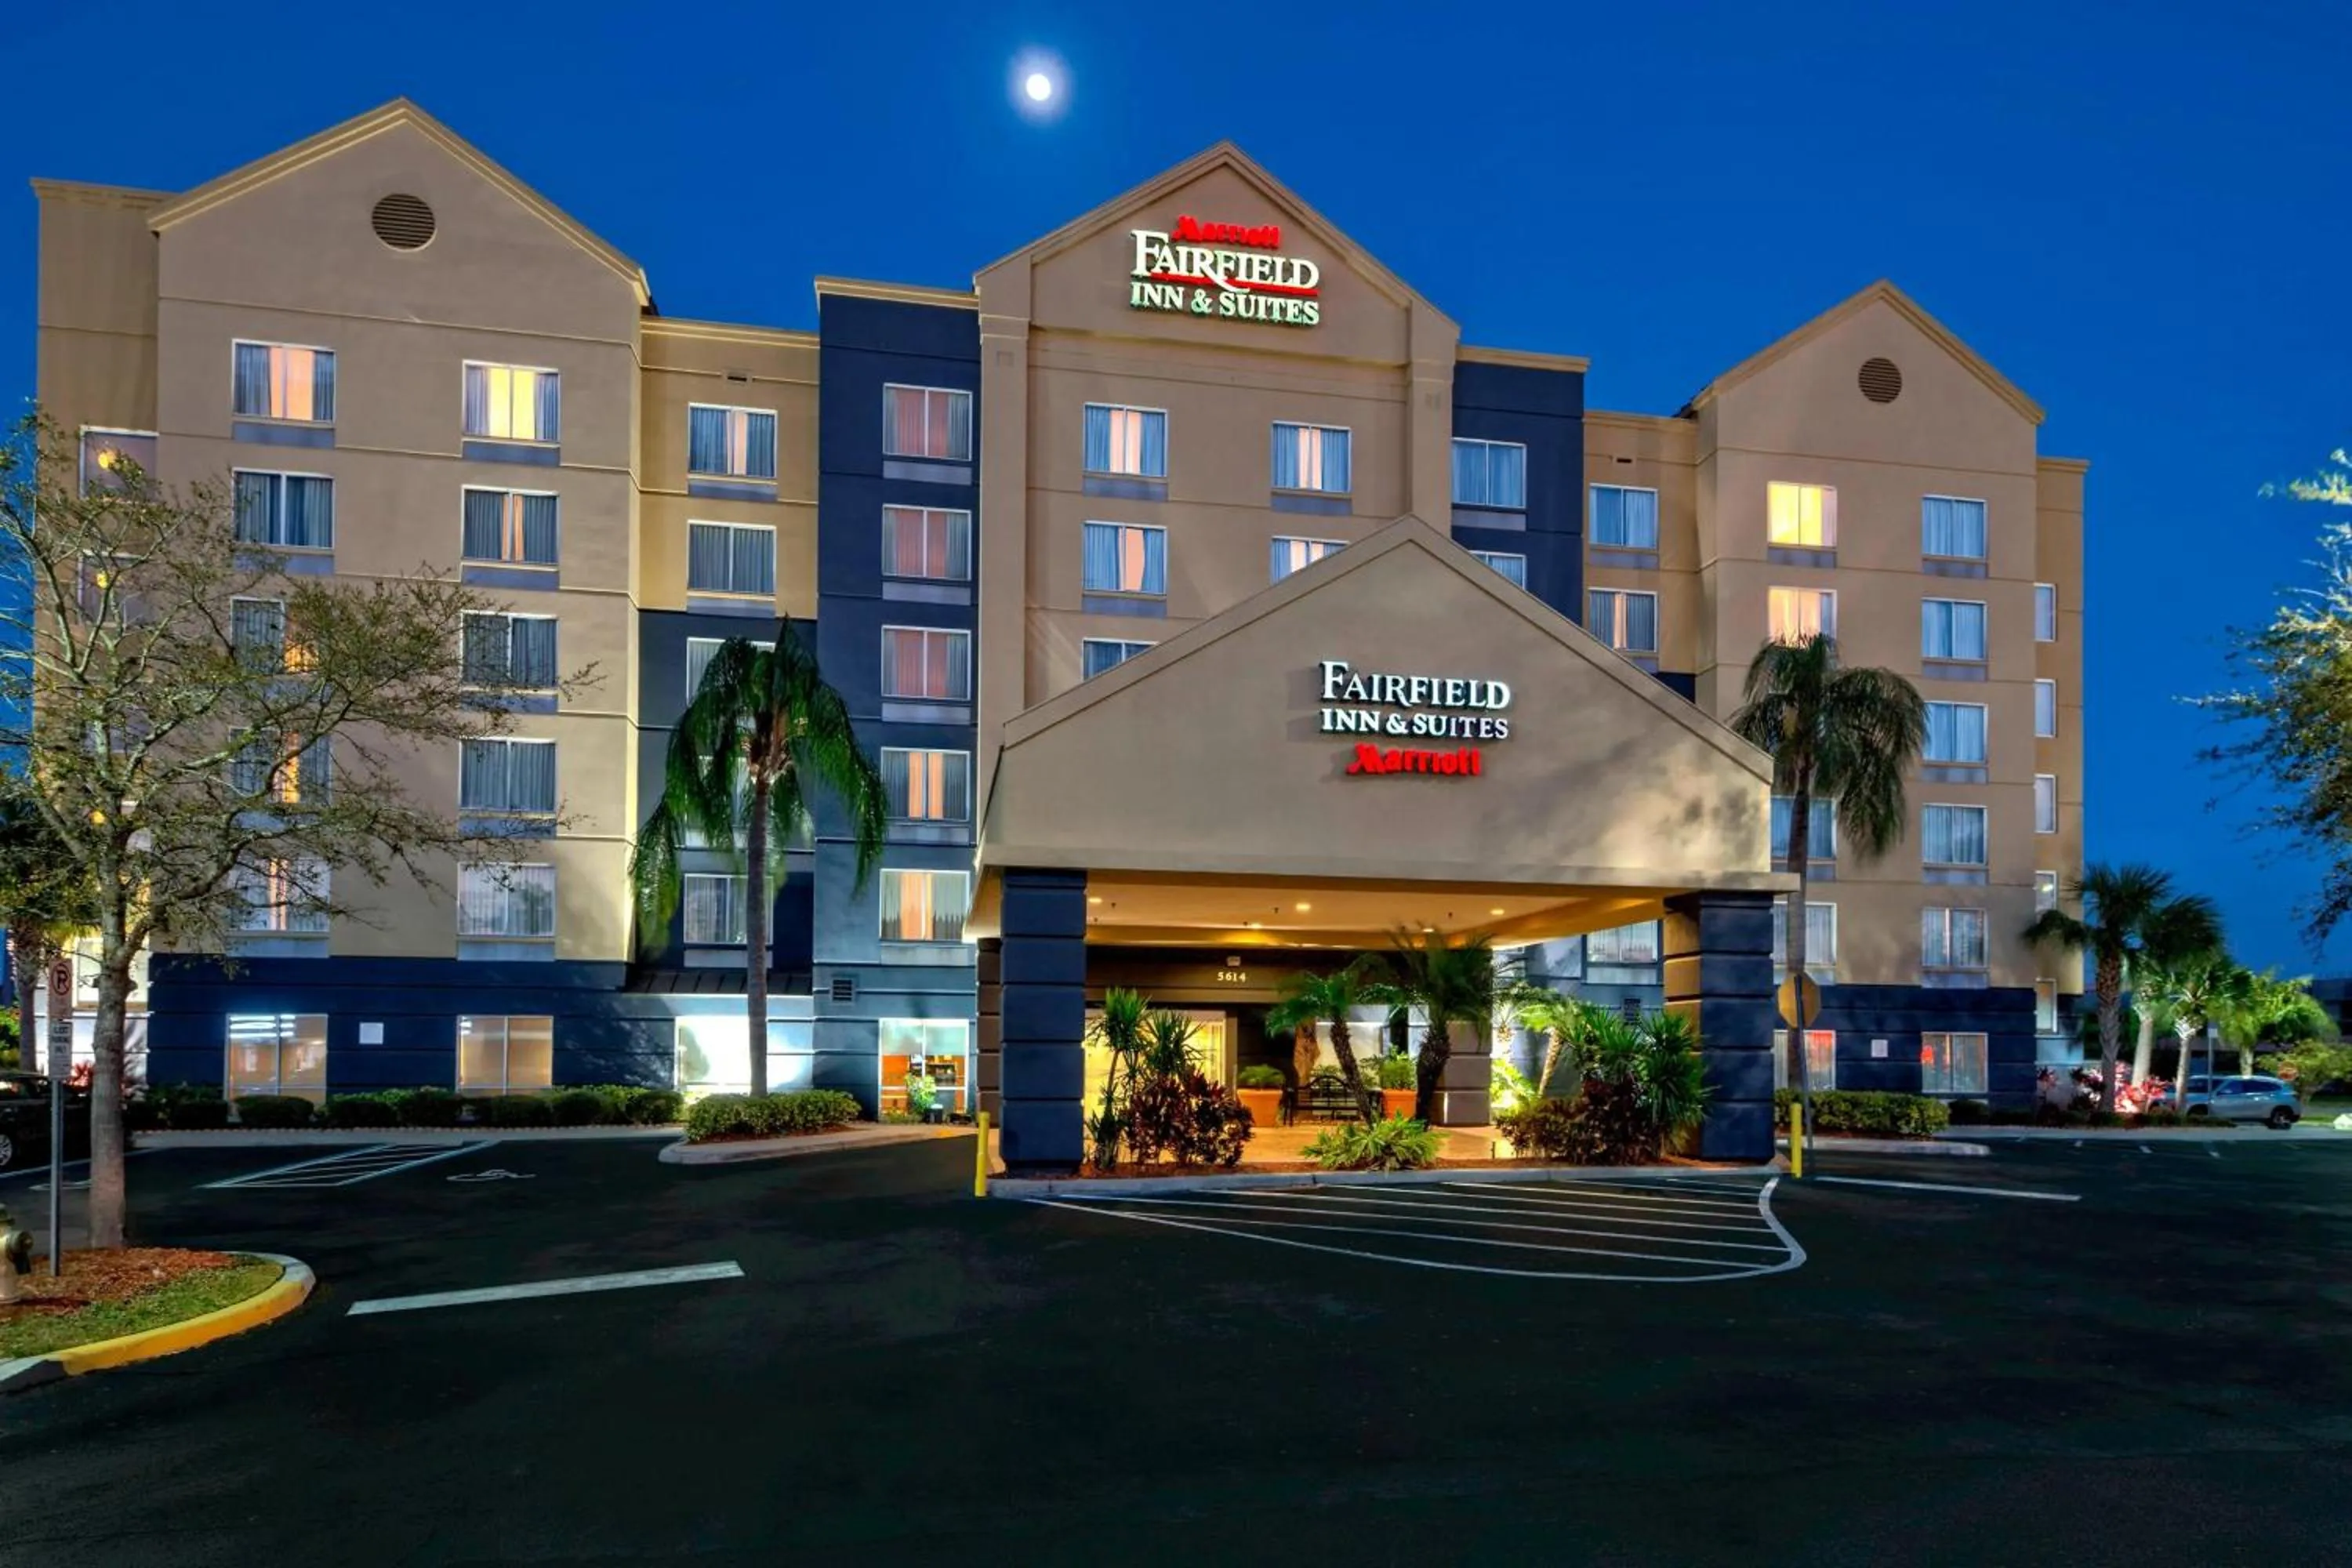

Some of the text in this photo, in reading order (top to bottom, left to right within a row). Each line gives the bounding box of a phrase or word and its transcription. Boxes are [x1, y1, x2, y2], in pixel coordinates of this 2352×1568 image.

[1172, 214, 1281, 249] Marriott
[1130, 229, 1320, 292] FAIRFIELD
[1130, 281, 1320, 325] INN & SUITES
[1320, 660, 1511, 710] FAIRFIELD
[1320, 707, 1509, 739] INN & SUITES
[1346, 742, 1482, 775] Marriott
[1216, 971, 1246, 983] 5614
